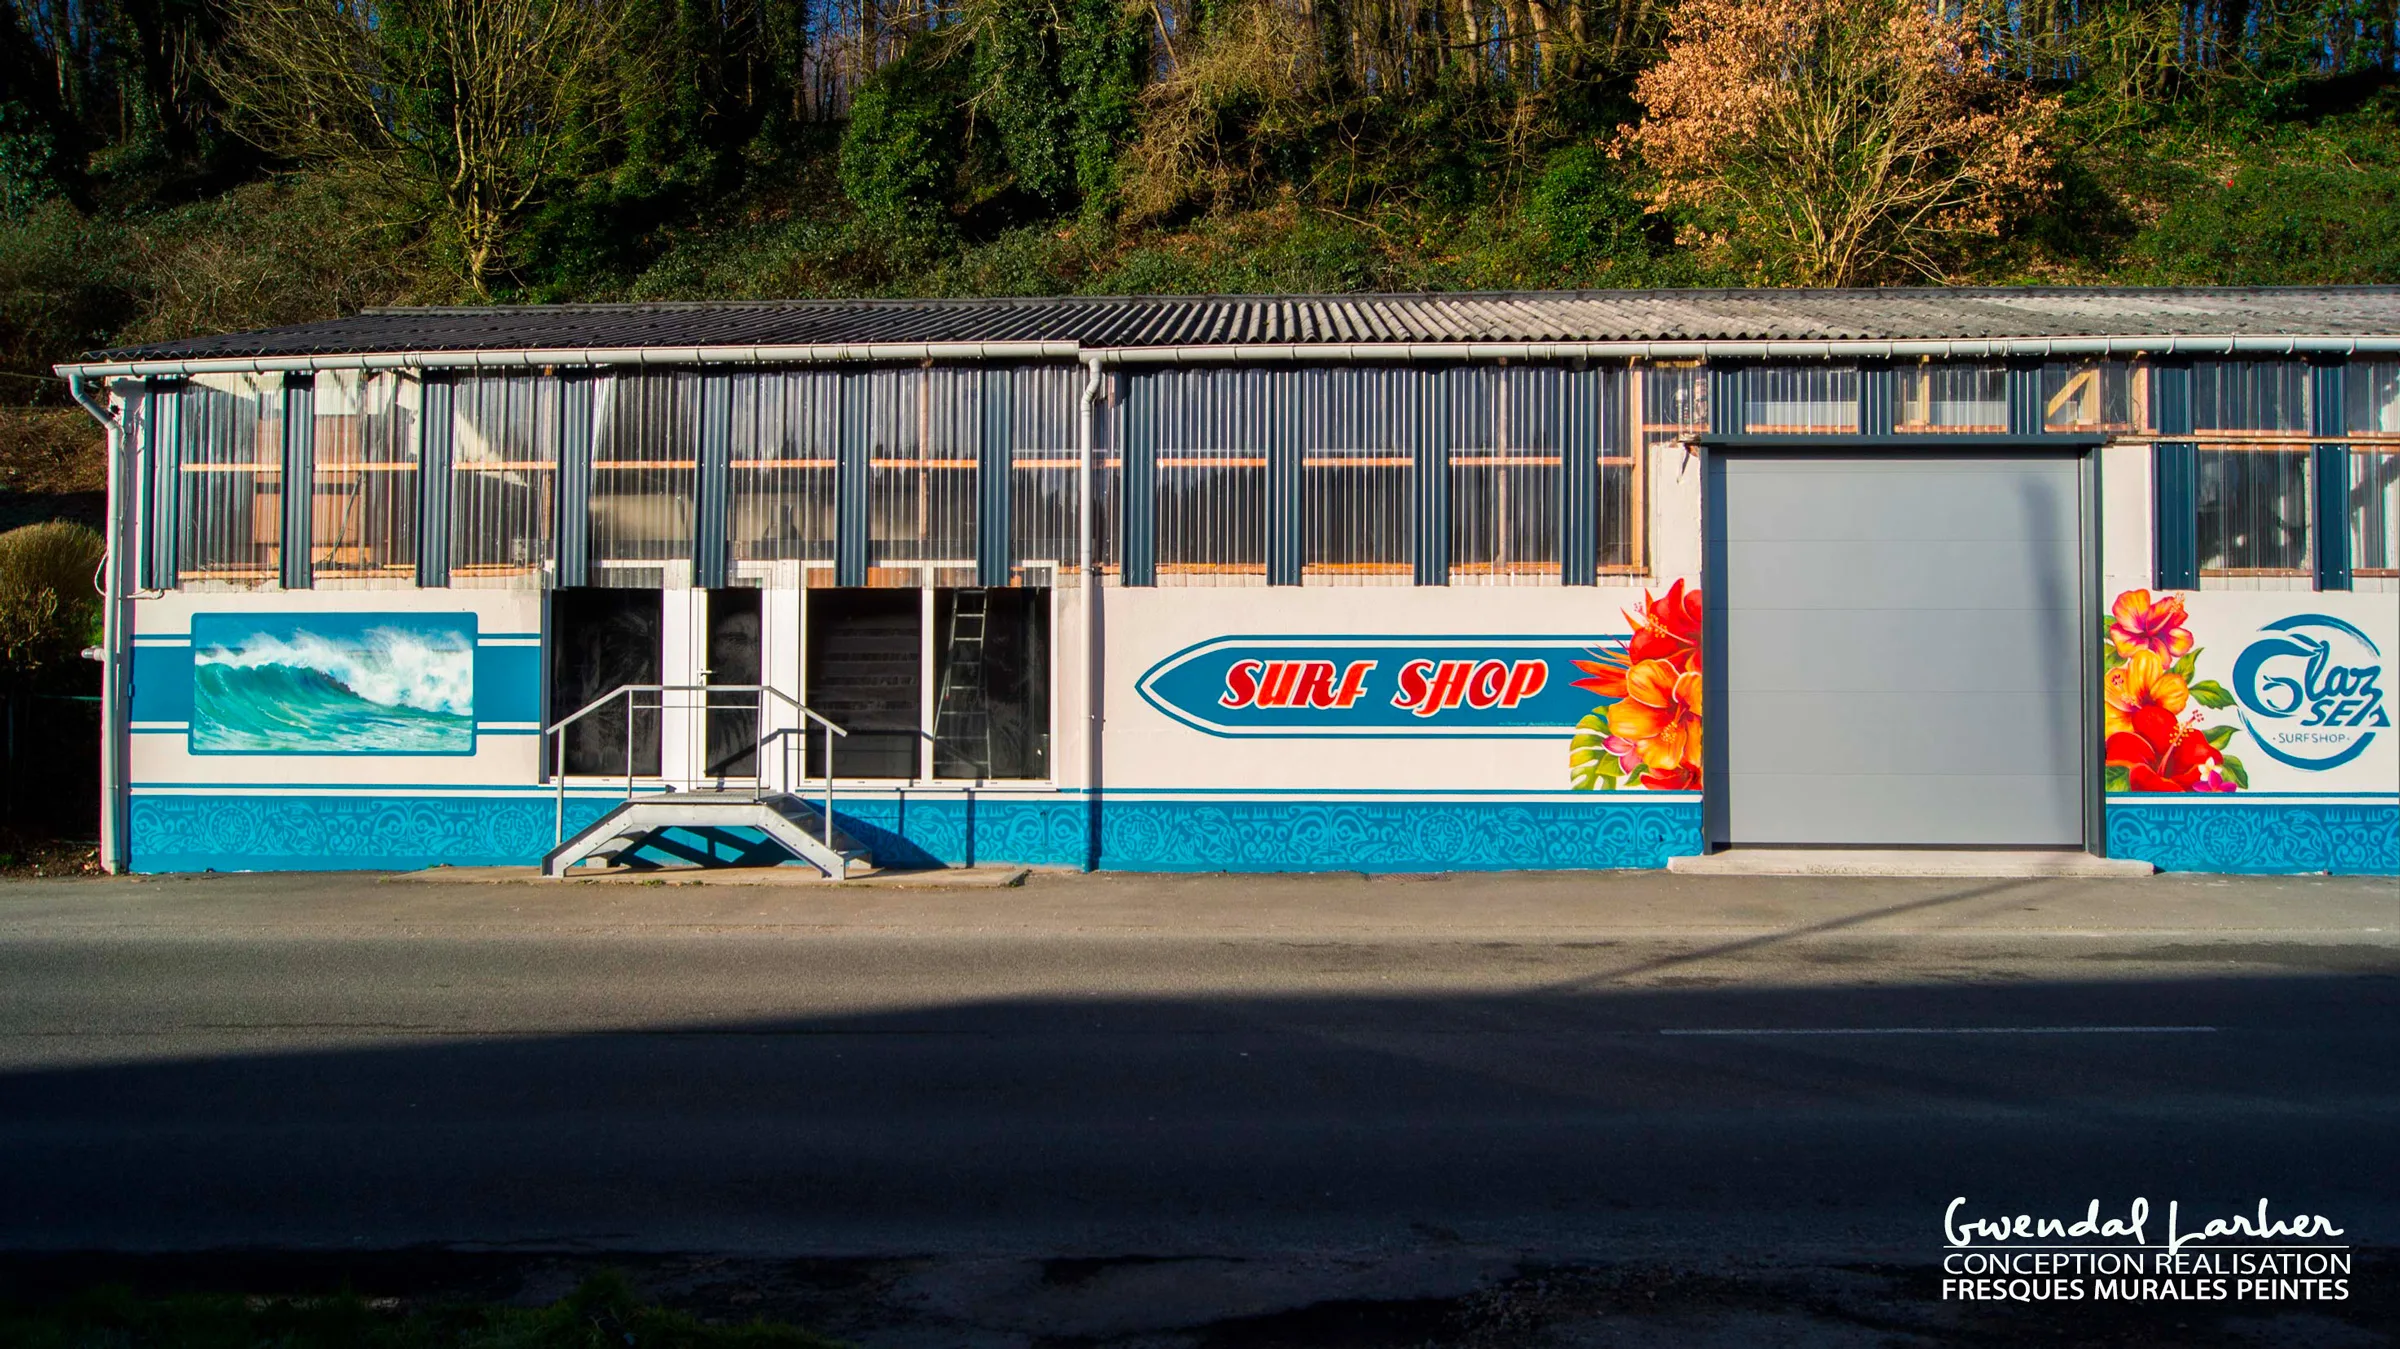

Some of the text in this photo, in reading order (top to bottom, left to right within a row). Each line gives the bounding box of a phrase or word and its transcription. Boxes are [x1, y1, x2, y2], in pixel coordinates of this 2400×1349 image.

[1218, 659, 1548, 715] SURF SHOP
[2300, 698, 2391, 727] SEA
[2278, 732, 2346, 744] SURF SHOP
